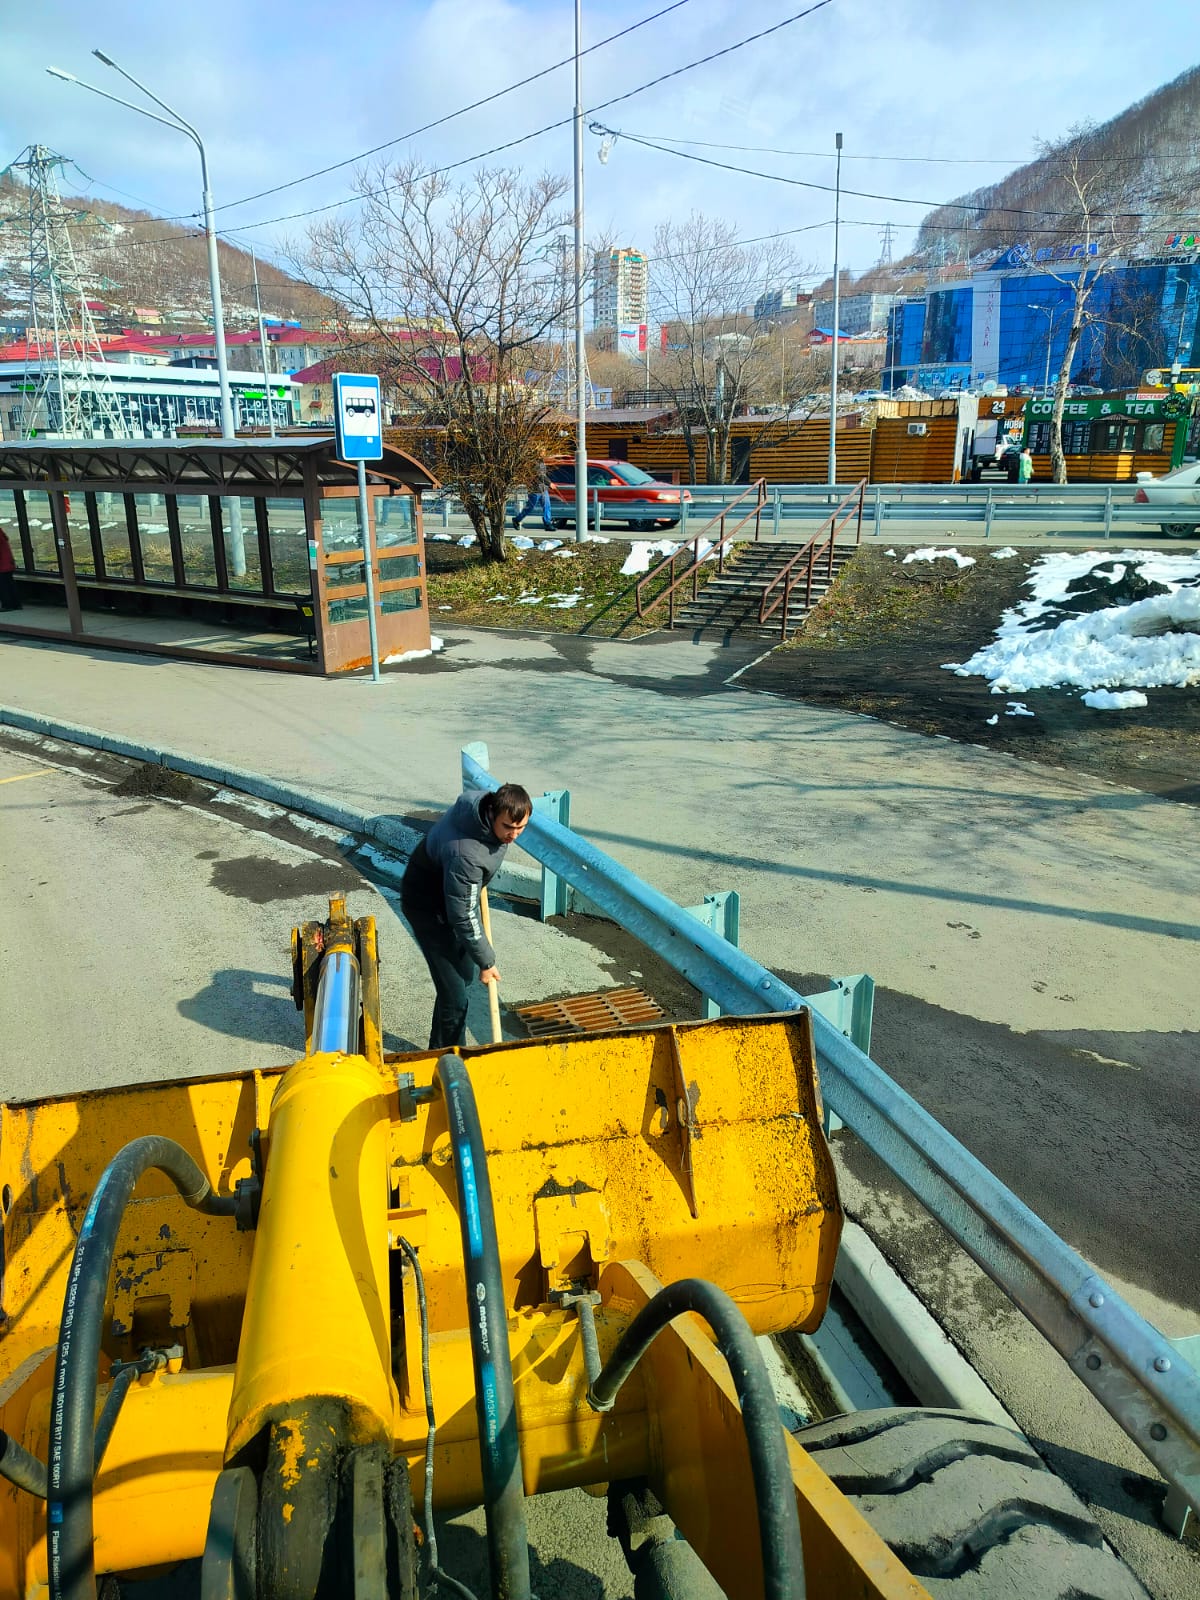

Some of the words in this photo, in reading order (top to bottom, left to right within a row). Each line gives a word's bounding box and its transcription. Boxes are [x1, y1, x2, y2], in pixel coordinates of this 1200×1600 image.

[1101, 403, 1112, 414] &
[1125, 403, 1155, 414] TEA
[72, 1264, 82, 1282] MPa
[68, 1284, 78, 1306] (3250
[64, 1309, 74, 1328] PSI)
[58, 1368, 67, 1390] mm)
[485, 1383, 497, 1417] 16M3K
[53, 1446, 62, 1461] SAE
[52, 1463, 61, 1489] 100R17
[52, 1530, 60, 1555] Flame
